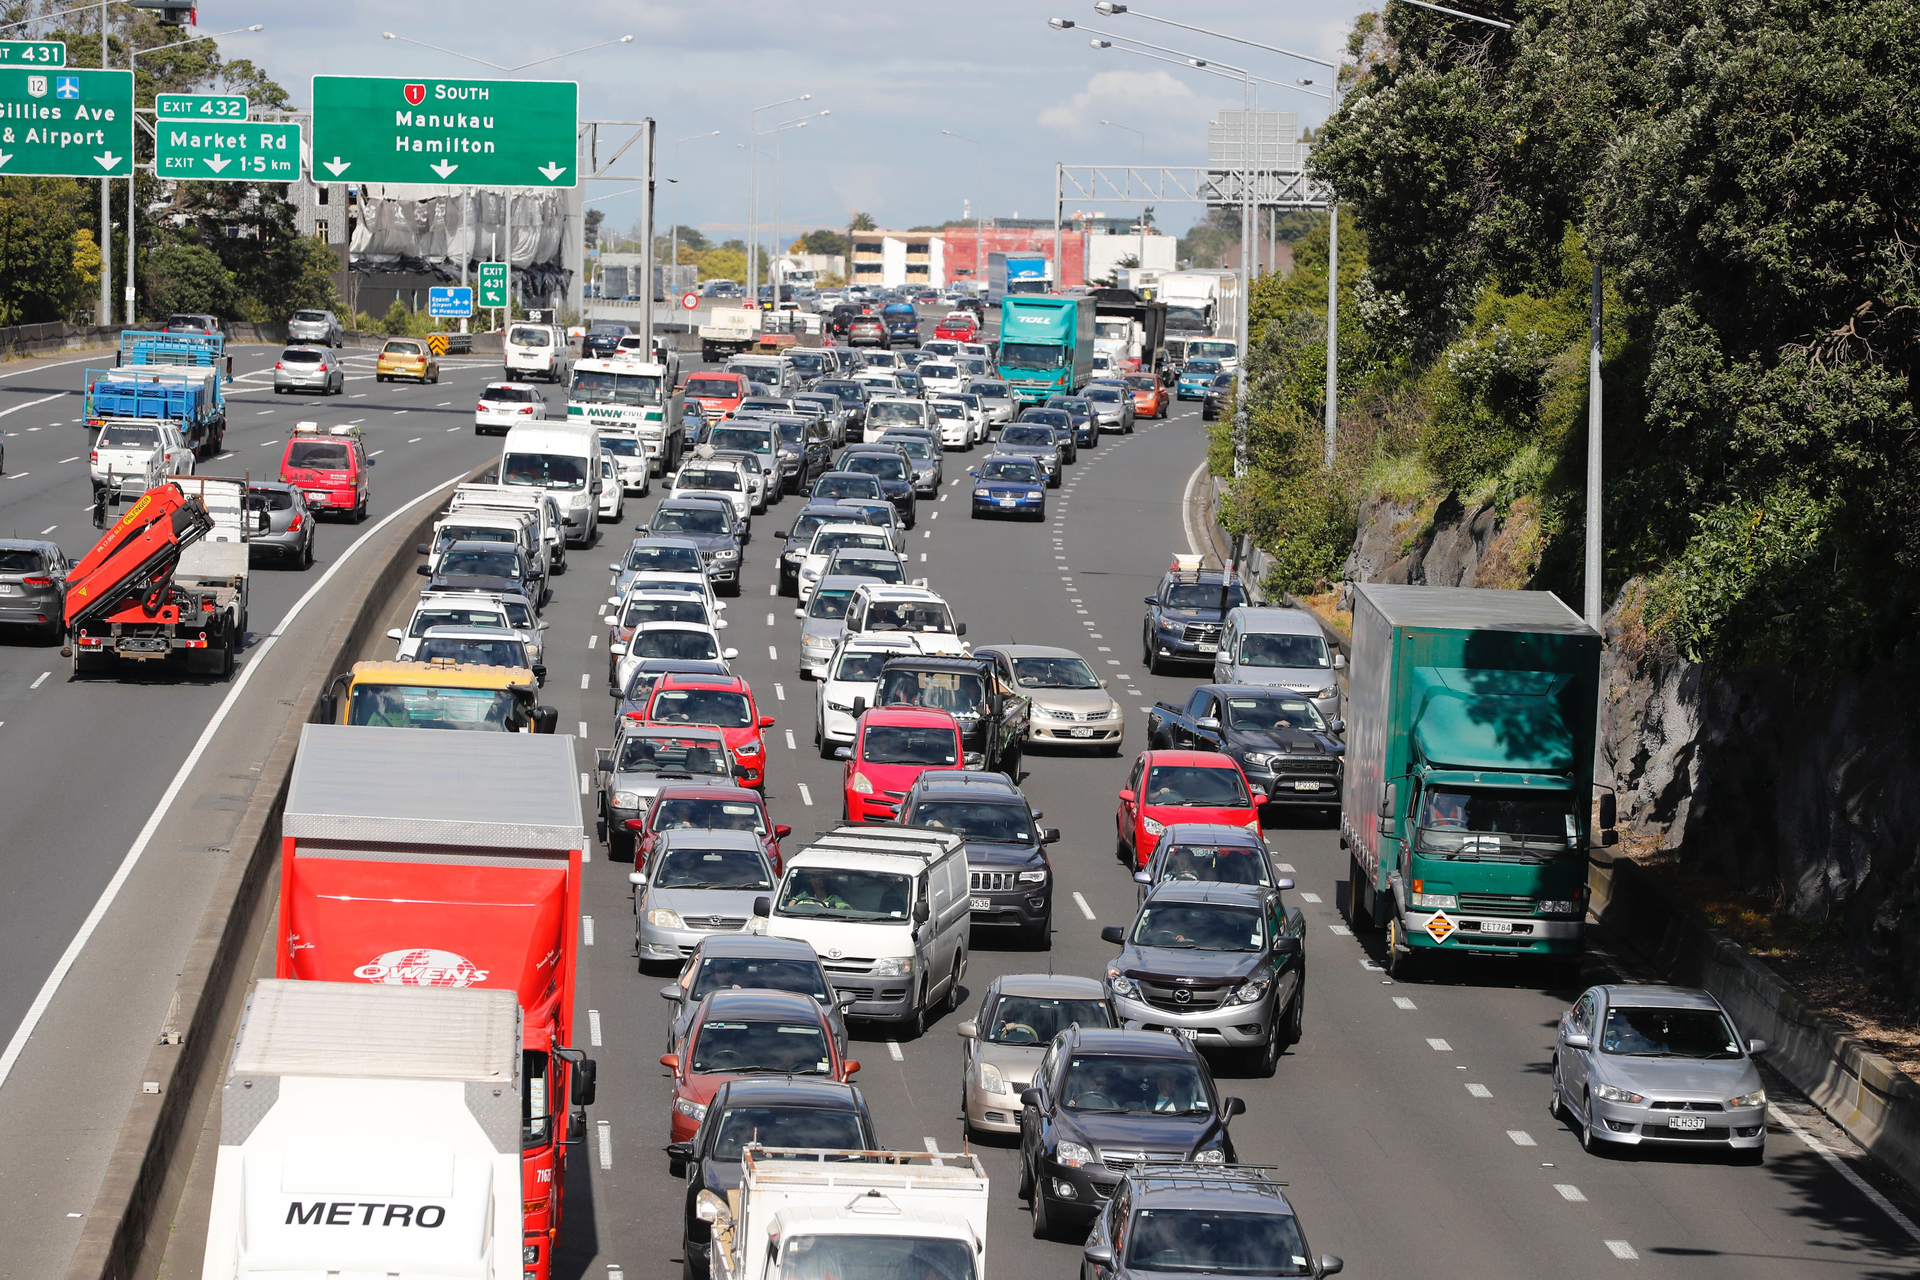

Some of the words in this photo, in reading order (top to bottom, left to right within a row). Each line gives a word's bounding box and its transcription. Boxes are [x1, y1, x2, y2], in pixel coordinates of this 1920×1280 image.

[21, 46, 58, 62] 431
[32, 80, 44, 91] 12
[412, 87, 418, 99] 1
[435, 84, 489, 100] SOUTH
[74, 104, 115, 121] Ave
[163, 102, 193, 112] EXIT
[200, 100, 240, 116] 432
[396, 111, 494, 128] Manukau
[2, 126, 15, 143] &
[25, 127, 104, 148] Airport
[170, 131, 247, 148] Market
[260, 133, 287, 149] Rd
[396, 136, 495, 153] Hamilton
[165, 157, 194, 168] EXIT
[271, 159, 291, 170] km
[483, 267, 503, 276] EXIT
[483, 279, 503, 288] 431
[1018, 316, 1051, 325] TOLL
[587, 407, 623, 418] MWN
[623, 410, 643, 418] CIVIL
[124, 497, 150, 524] PALFINGER
[1482, 922, 1511, 931] EET784
[353, 964, 490, 982] OWENS
[1670, 1118, 1704, 1128] HLH337
[285, 1202, 446, 1228] METRO
